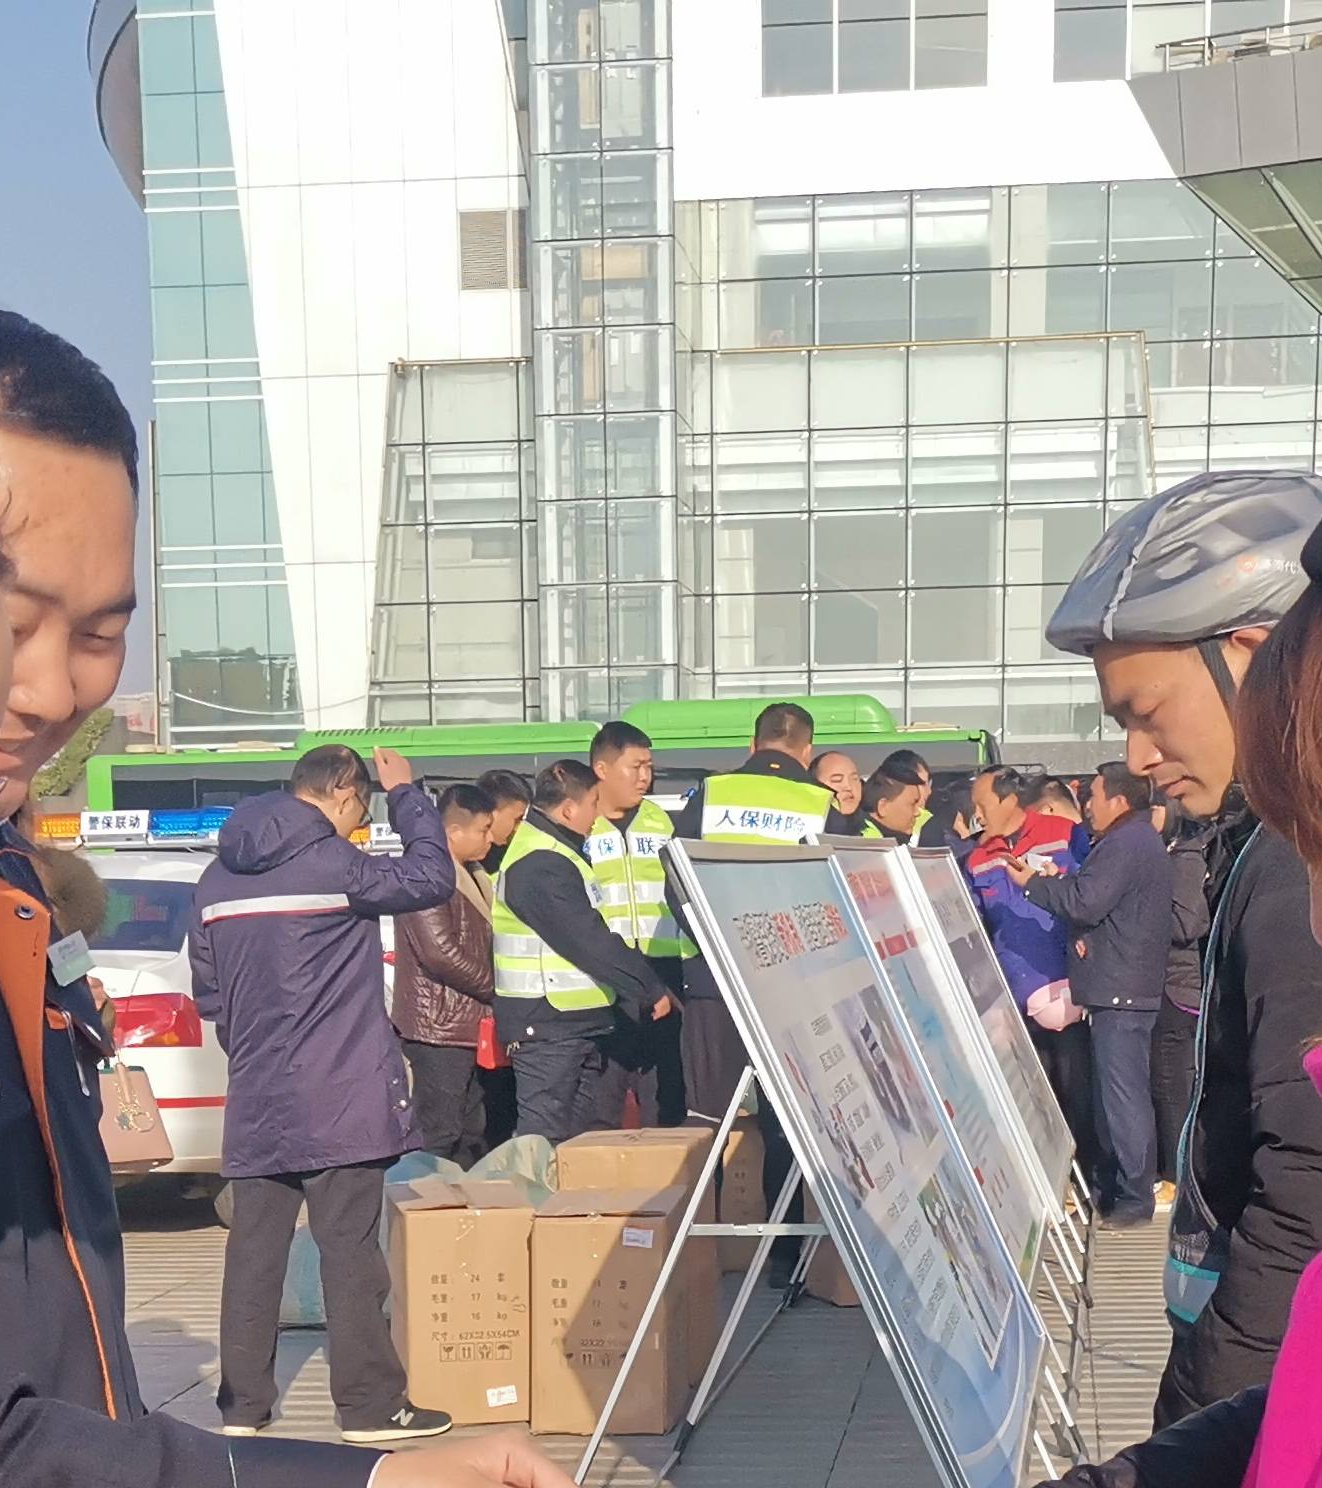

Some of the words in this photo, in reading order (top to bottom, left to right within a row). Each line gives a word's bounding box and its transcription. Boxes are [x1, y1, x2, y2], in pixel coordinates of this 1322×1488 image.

[88, 815, 142, 831] 警保联动
[716, 809, 805, 832] 人保财险
